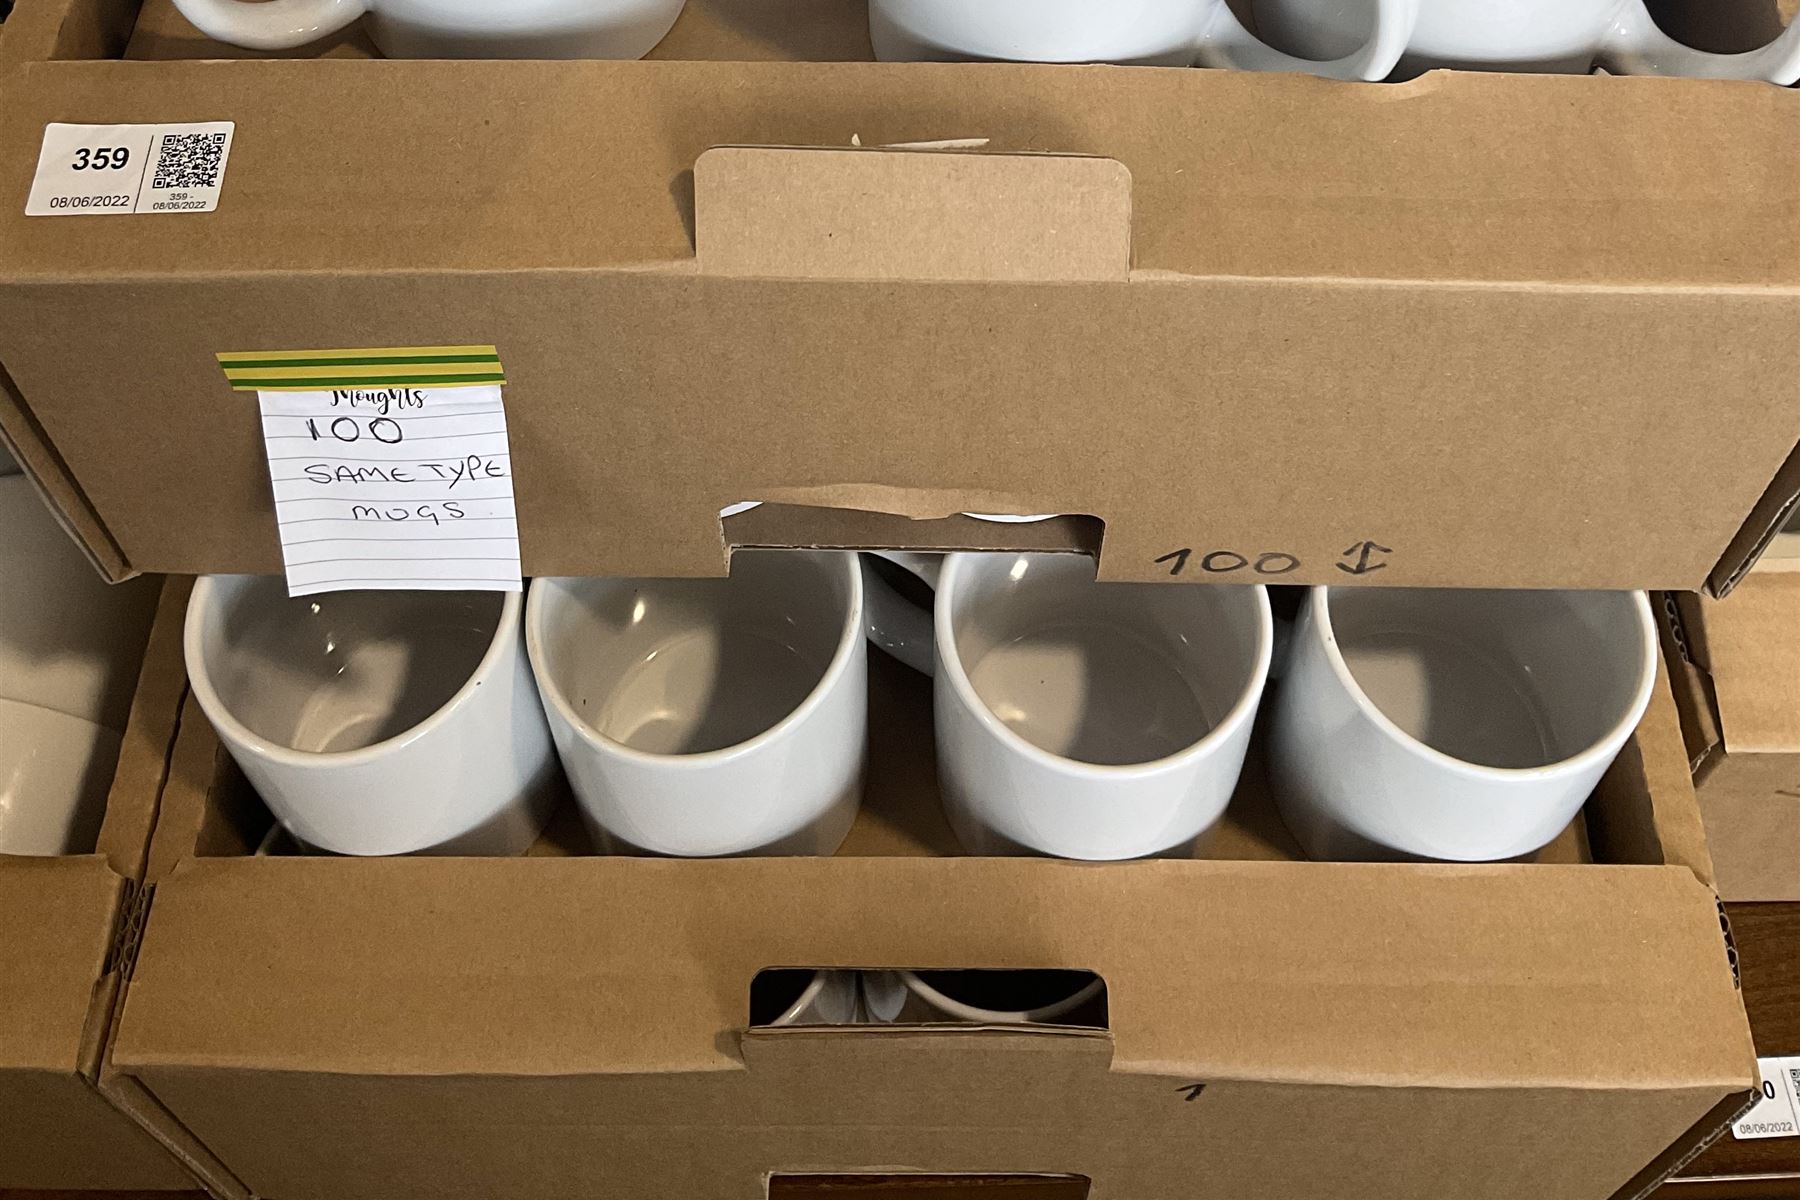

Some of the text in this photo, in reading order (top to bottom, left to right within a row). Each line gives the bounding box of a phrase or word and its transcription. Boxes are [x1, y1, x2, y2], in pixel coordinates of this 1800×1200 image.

[71, 147, 130, 171] 359
[49, 195, 130, 209] 08/06/2022
[152, 201, 207, 210] 08/06/2022
[169, 193, 188, 201] 359
[305, 417, 403, 444] 100
[304, 455, 506, 489] SAME TYPE
[1154, 548, 1300, 575] 100
[1740, 1121, 1793, 1134] 08/06/2022
